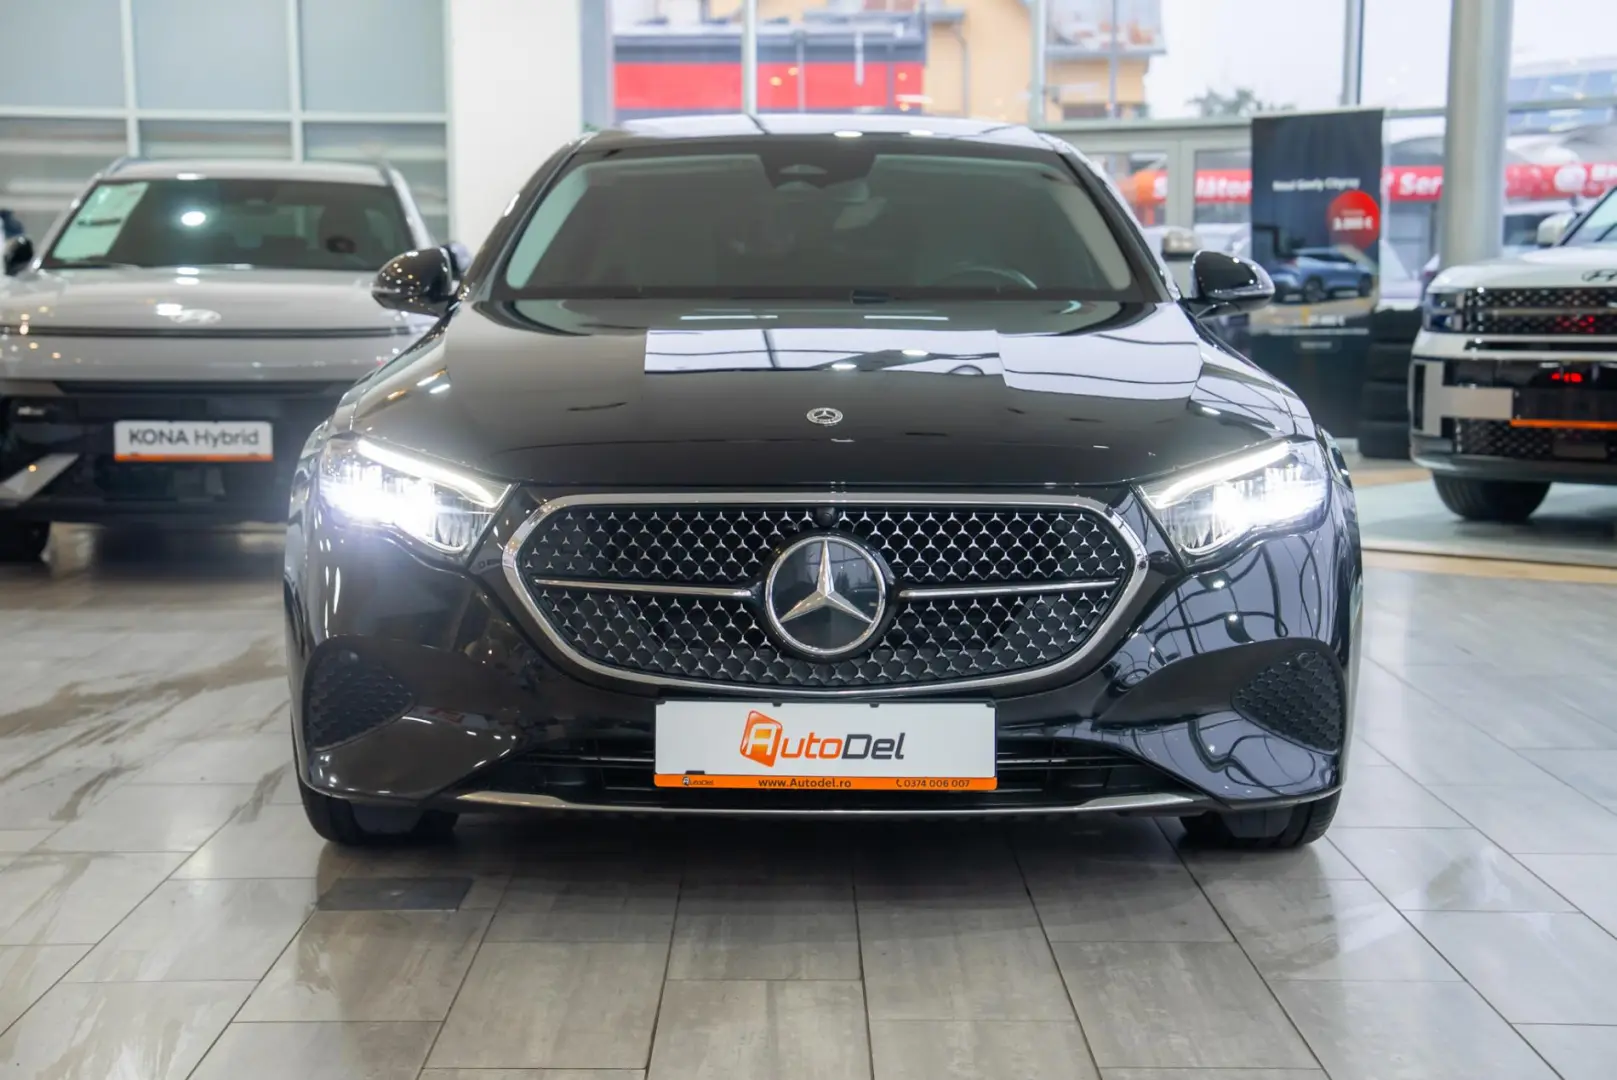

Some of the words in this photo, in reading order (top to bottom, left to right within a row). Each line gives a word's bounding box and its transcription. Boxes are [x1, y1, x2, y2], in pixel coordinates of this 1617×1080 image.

[129, 427, 189, 445] KONA
[194, 427, 260, 448] Hybrid
[742, 714, 906, 765] AutoDel
[758, 777, 852, 788] www.Autodel.ro
[904, 779, 927, 788] 0374
[929, 779, 949, 788] 006
[951, 779, 970, 788] 007
